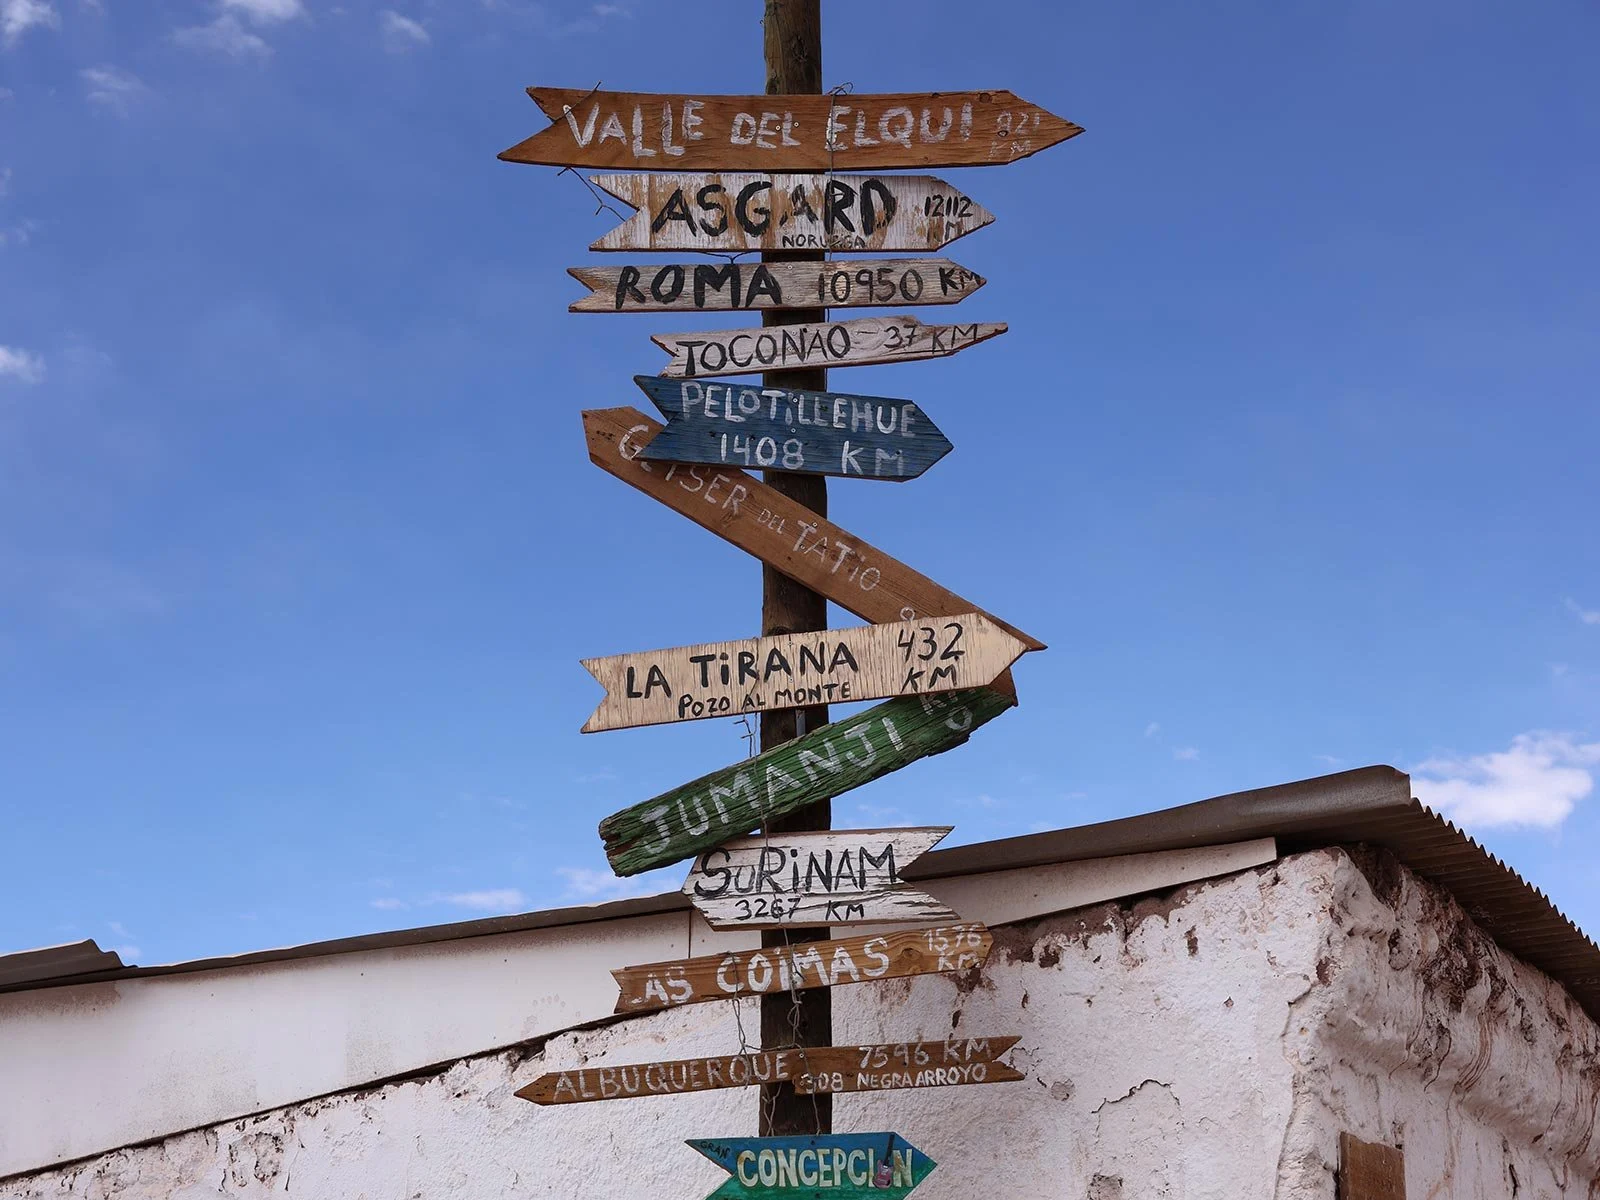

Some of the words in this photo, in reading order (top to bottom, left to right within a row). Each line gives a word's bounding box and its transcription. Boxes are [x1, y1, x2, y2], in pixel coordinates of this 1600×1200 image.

[563, 101, 705, 158] VALLE
[730, 111, 800, 150] DEL
[824, 102, 973, 151] ELQUI
[652, 179, 897, 238] ASGARD
[925, 195, 974, 218] 12112
[616, 264, 783, 310] ROMA
[818, 267, 924, 303] 10950
[938, 266, 985, 296] KM
[682, 325, 852, 377] TOCONAO
[884, 324, 918, 351] 37
[931, 323, 980, 354] KM
[720, 432, 806, 471] 1408
[841, 440, 905, 477] KM
[757, 508, 786, 535] DEL
[897, 622, 966, 664] 432
[625, 664, 672, 701] LA
[900, 663, 959, 694] KM
[678, 692, 731, 719] POZO
[741, 687, 767, 711] AL
[774, 681, 851, 706] MONTE
[640, 715, 904, 856] JUMANJI
[735, 898, 801, 921] 3267
[825, 900, 865, 921] KM
[923, 925, 982, 952] 1576
[943, 1039, 992, 1063] KM
[552, 1052, 789, 1103] ALBUQUERQUE
[800, 1072, 844, 1094] 308
